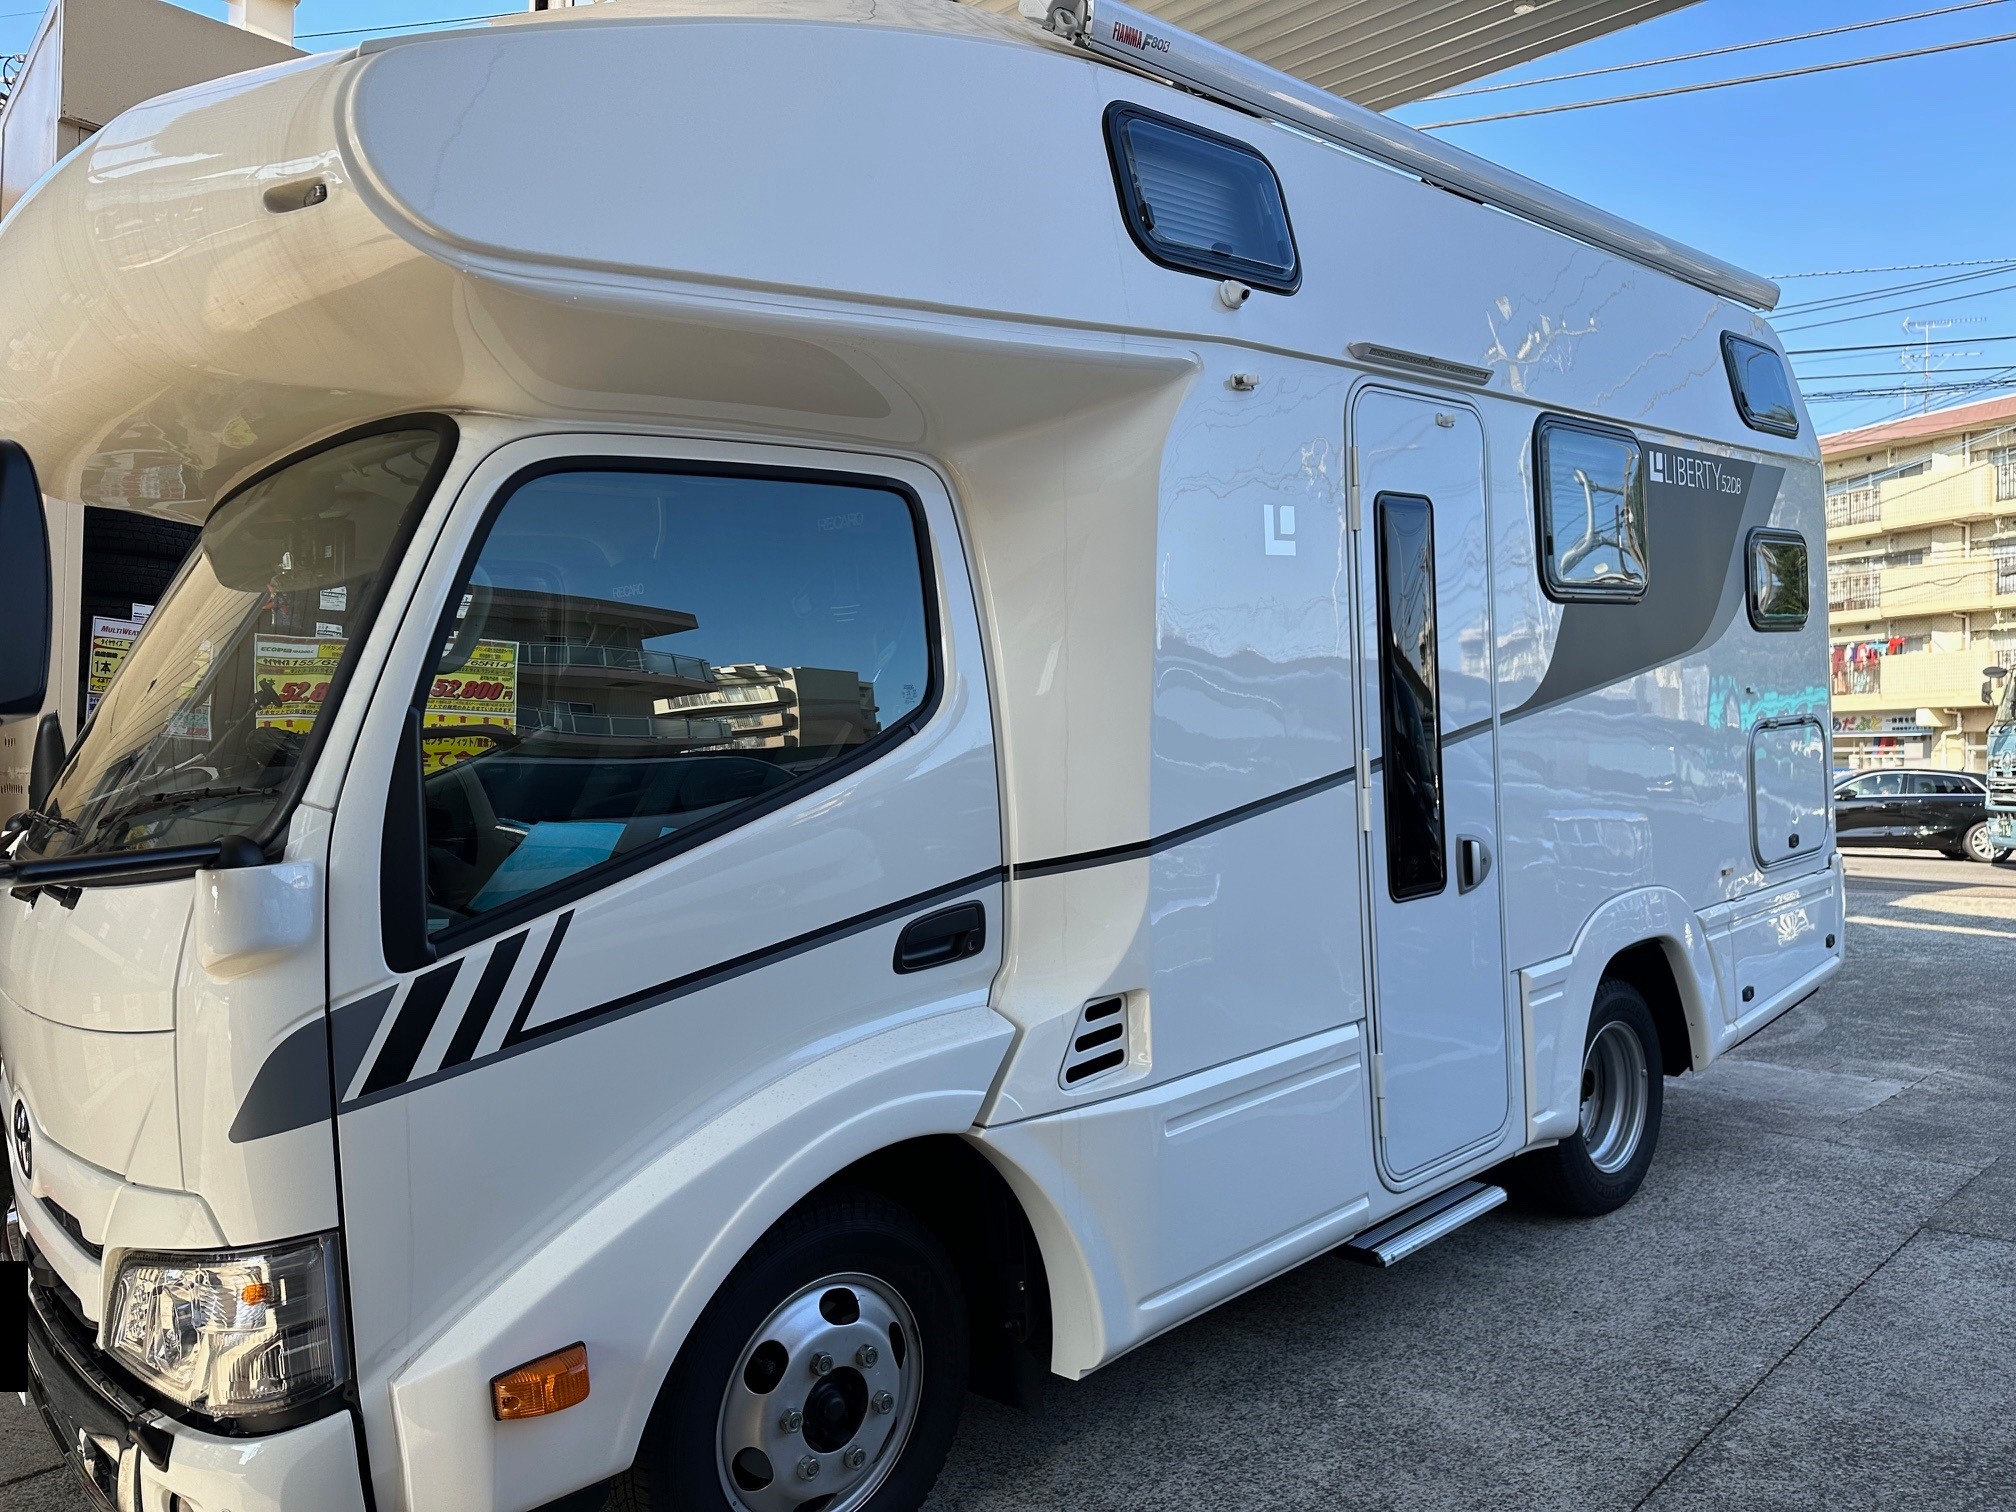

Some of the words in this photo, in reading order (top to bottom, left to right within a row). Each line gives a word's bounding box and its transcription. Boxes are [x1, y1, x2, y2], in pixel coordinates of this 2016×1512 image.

[1112, 21, 1143, 50] FIAMMA
[1664, 453, 1722, 491] LIBERTY
[1721, 474, 1742, 495] 52DB
[94, 660, 111, 674] 1本
